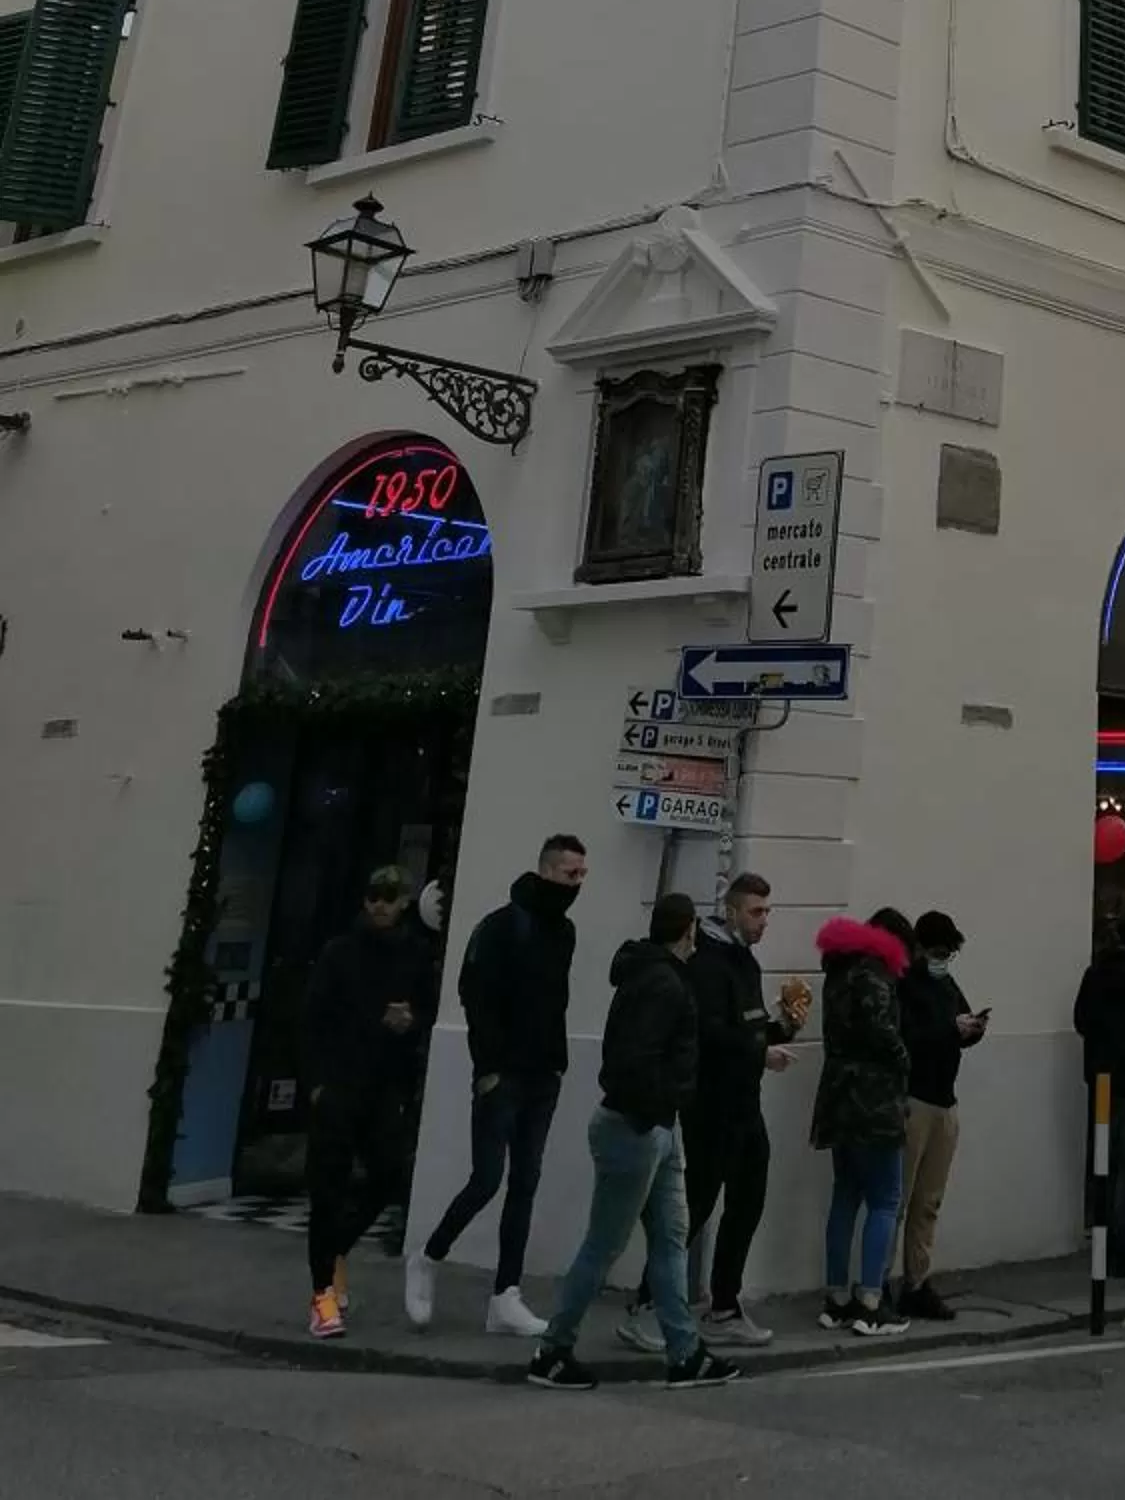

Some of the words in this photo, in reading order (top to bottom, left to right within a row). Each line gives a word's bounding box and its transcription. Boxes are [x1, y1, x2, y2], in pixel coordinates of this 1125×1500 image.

[364, 465, 457, 518] 1950
[767, 518, 823, 541] mercato
[763, 548, 821, 571] centrale
[661, 797, 720, 818] GARAG
